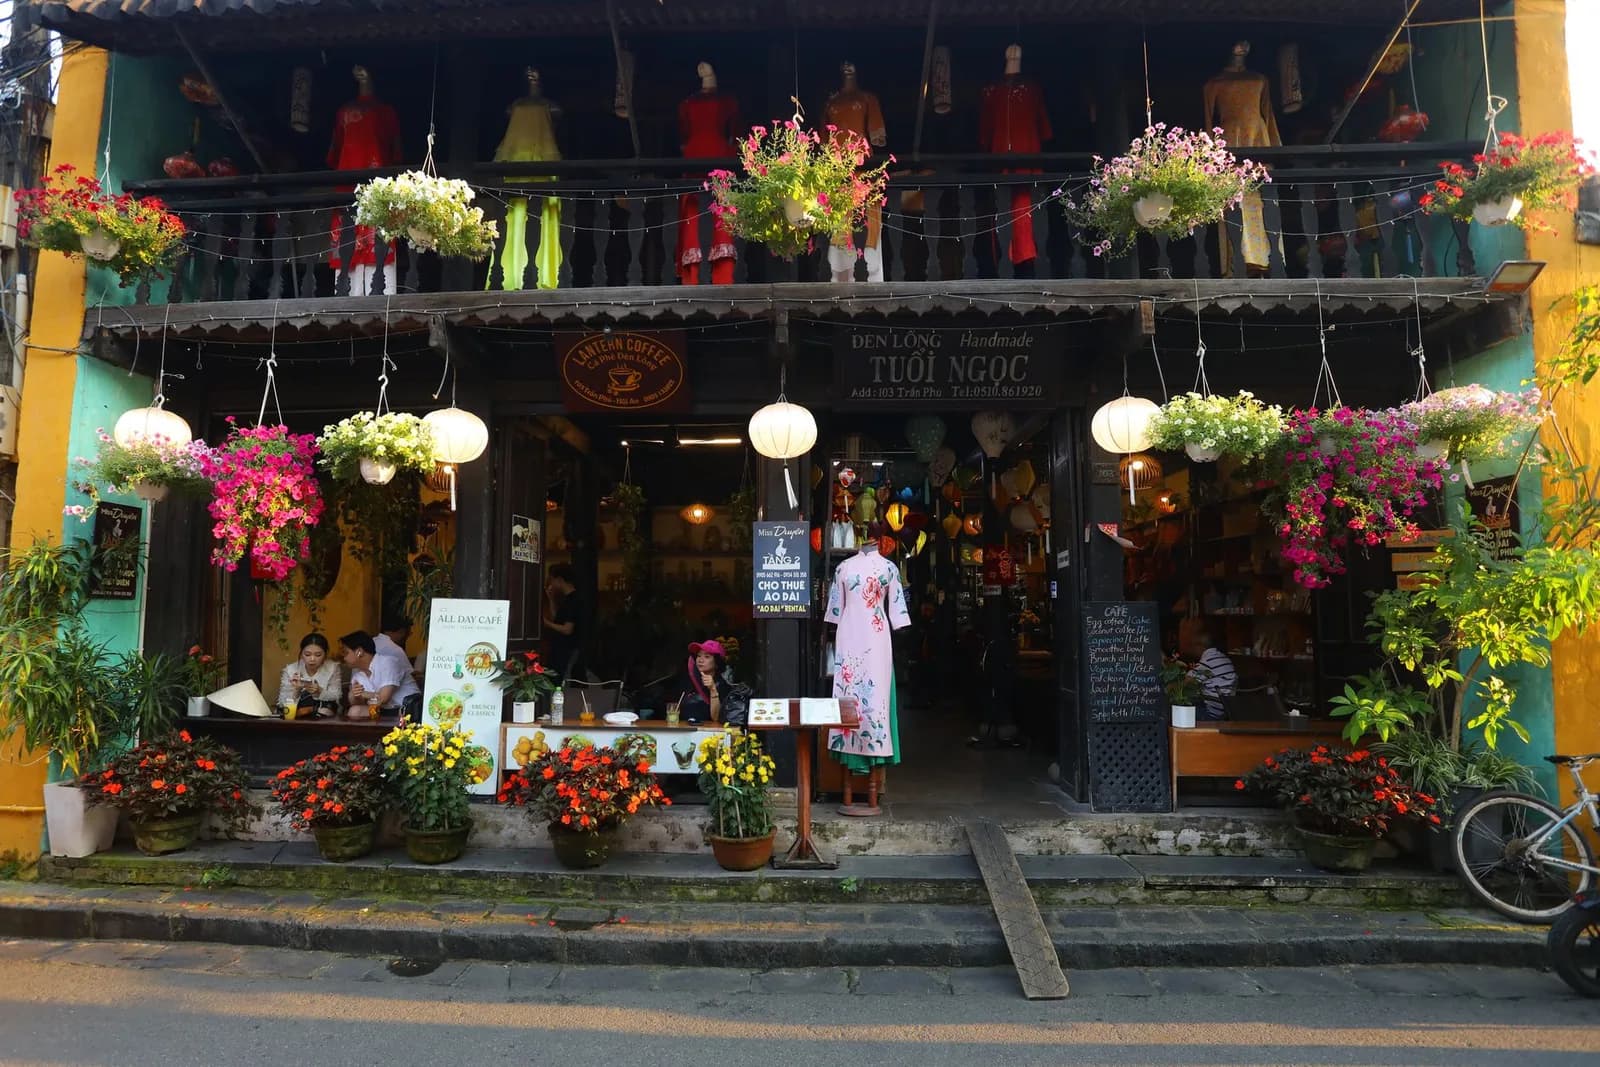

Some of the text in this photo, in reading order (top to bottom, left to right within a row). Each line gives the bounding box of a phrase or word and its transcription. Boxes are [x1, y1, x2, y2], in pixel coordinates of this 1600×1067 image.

[960, 331, 1034, 348] Handmade
[572, 338, 671, 366] LANTERN COFFEE
[947, 355, 1029, 387] NGỌC
[758, 580, 779, 590] CHO
[437, 614, 456, 623] ALL
[458, 615, 477, 624] DAY
[1086, 616, 1102, 628] Egg
[1104, 616, 1124, 626] coffee
[1126, 643, 1144, 653] bowl
[1090, 652, 1116, 664] Brunch
[1130, 654, 1145, 665] day
